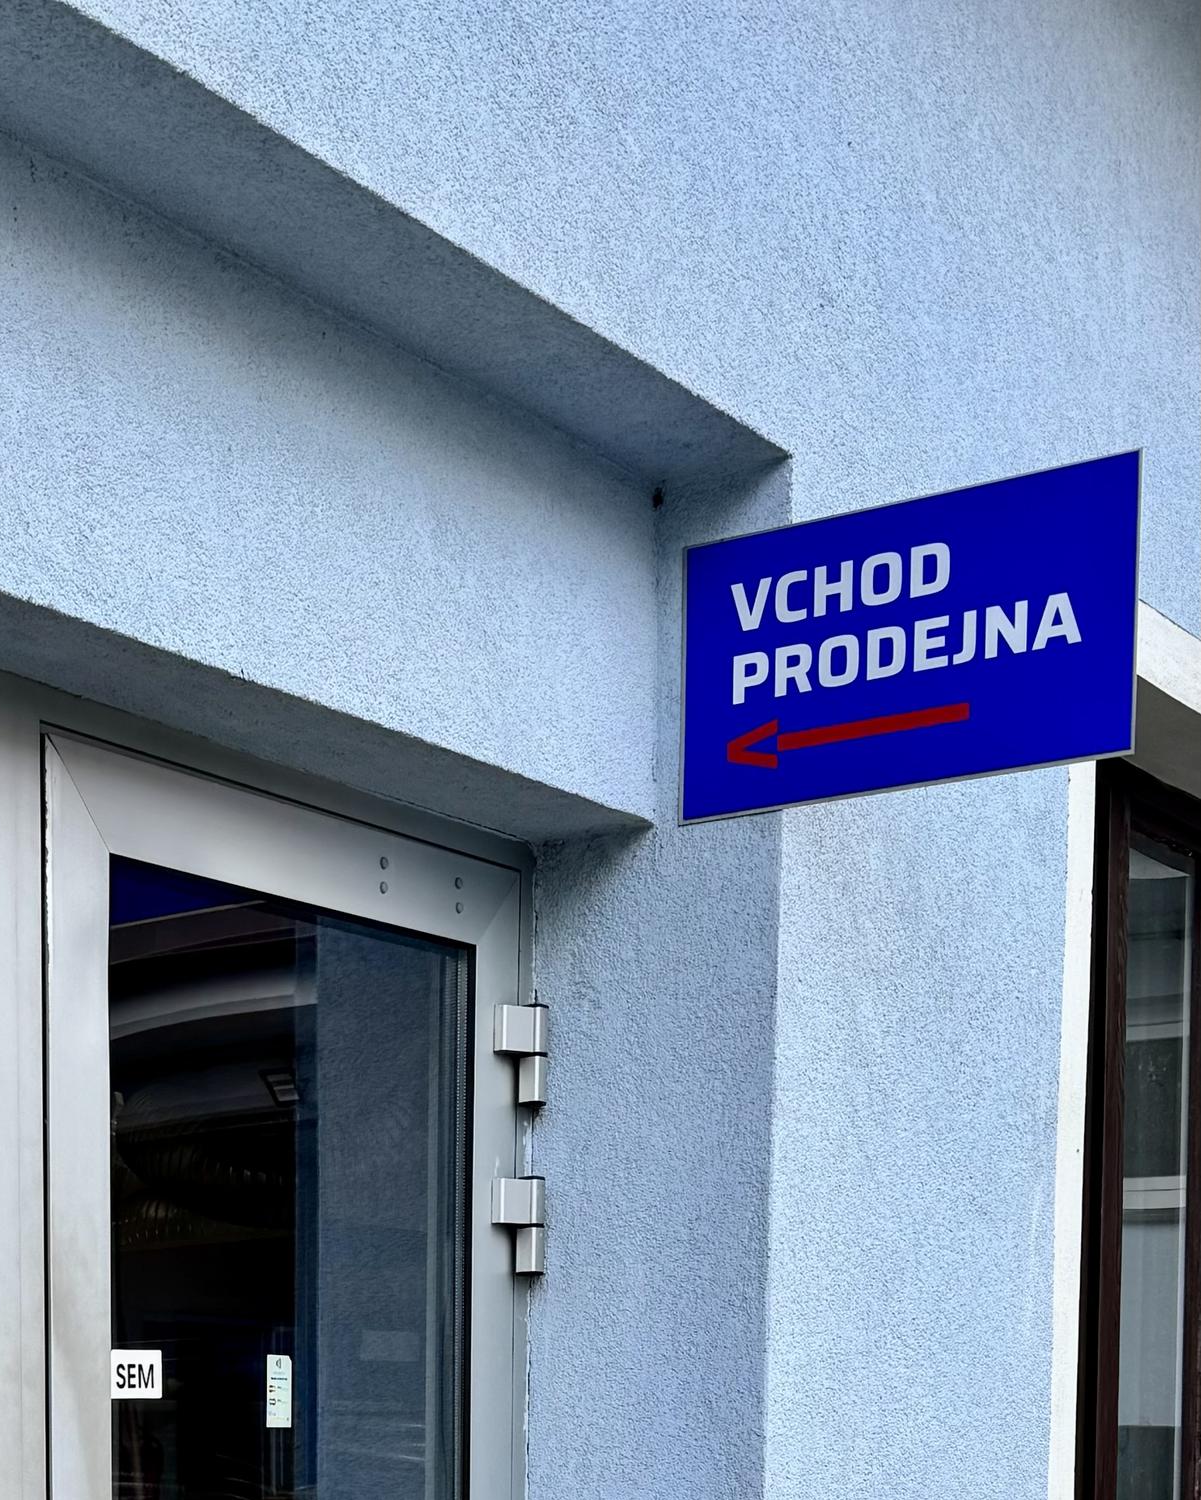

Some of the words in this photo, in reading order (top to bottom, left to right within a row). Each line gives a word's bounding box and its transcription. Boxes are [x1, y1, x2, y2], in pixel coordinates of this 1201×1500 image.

[730, 541, 952, 632] VCHOD
[731, 591, 1083, 706] PRODEJNA
[116, 1363, 154, 1389] SEM
